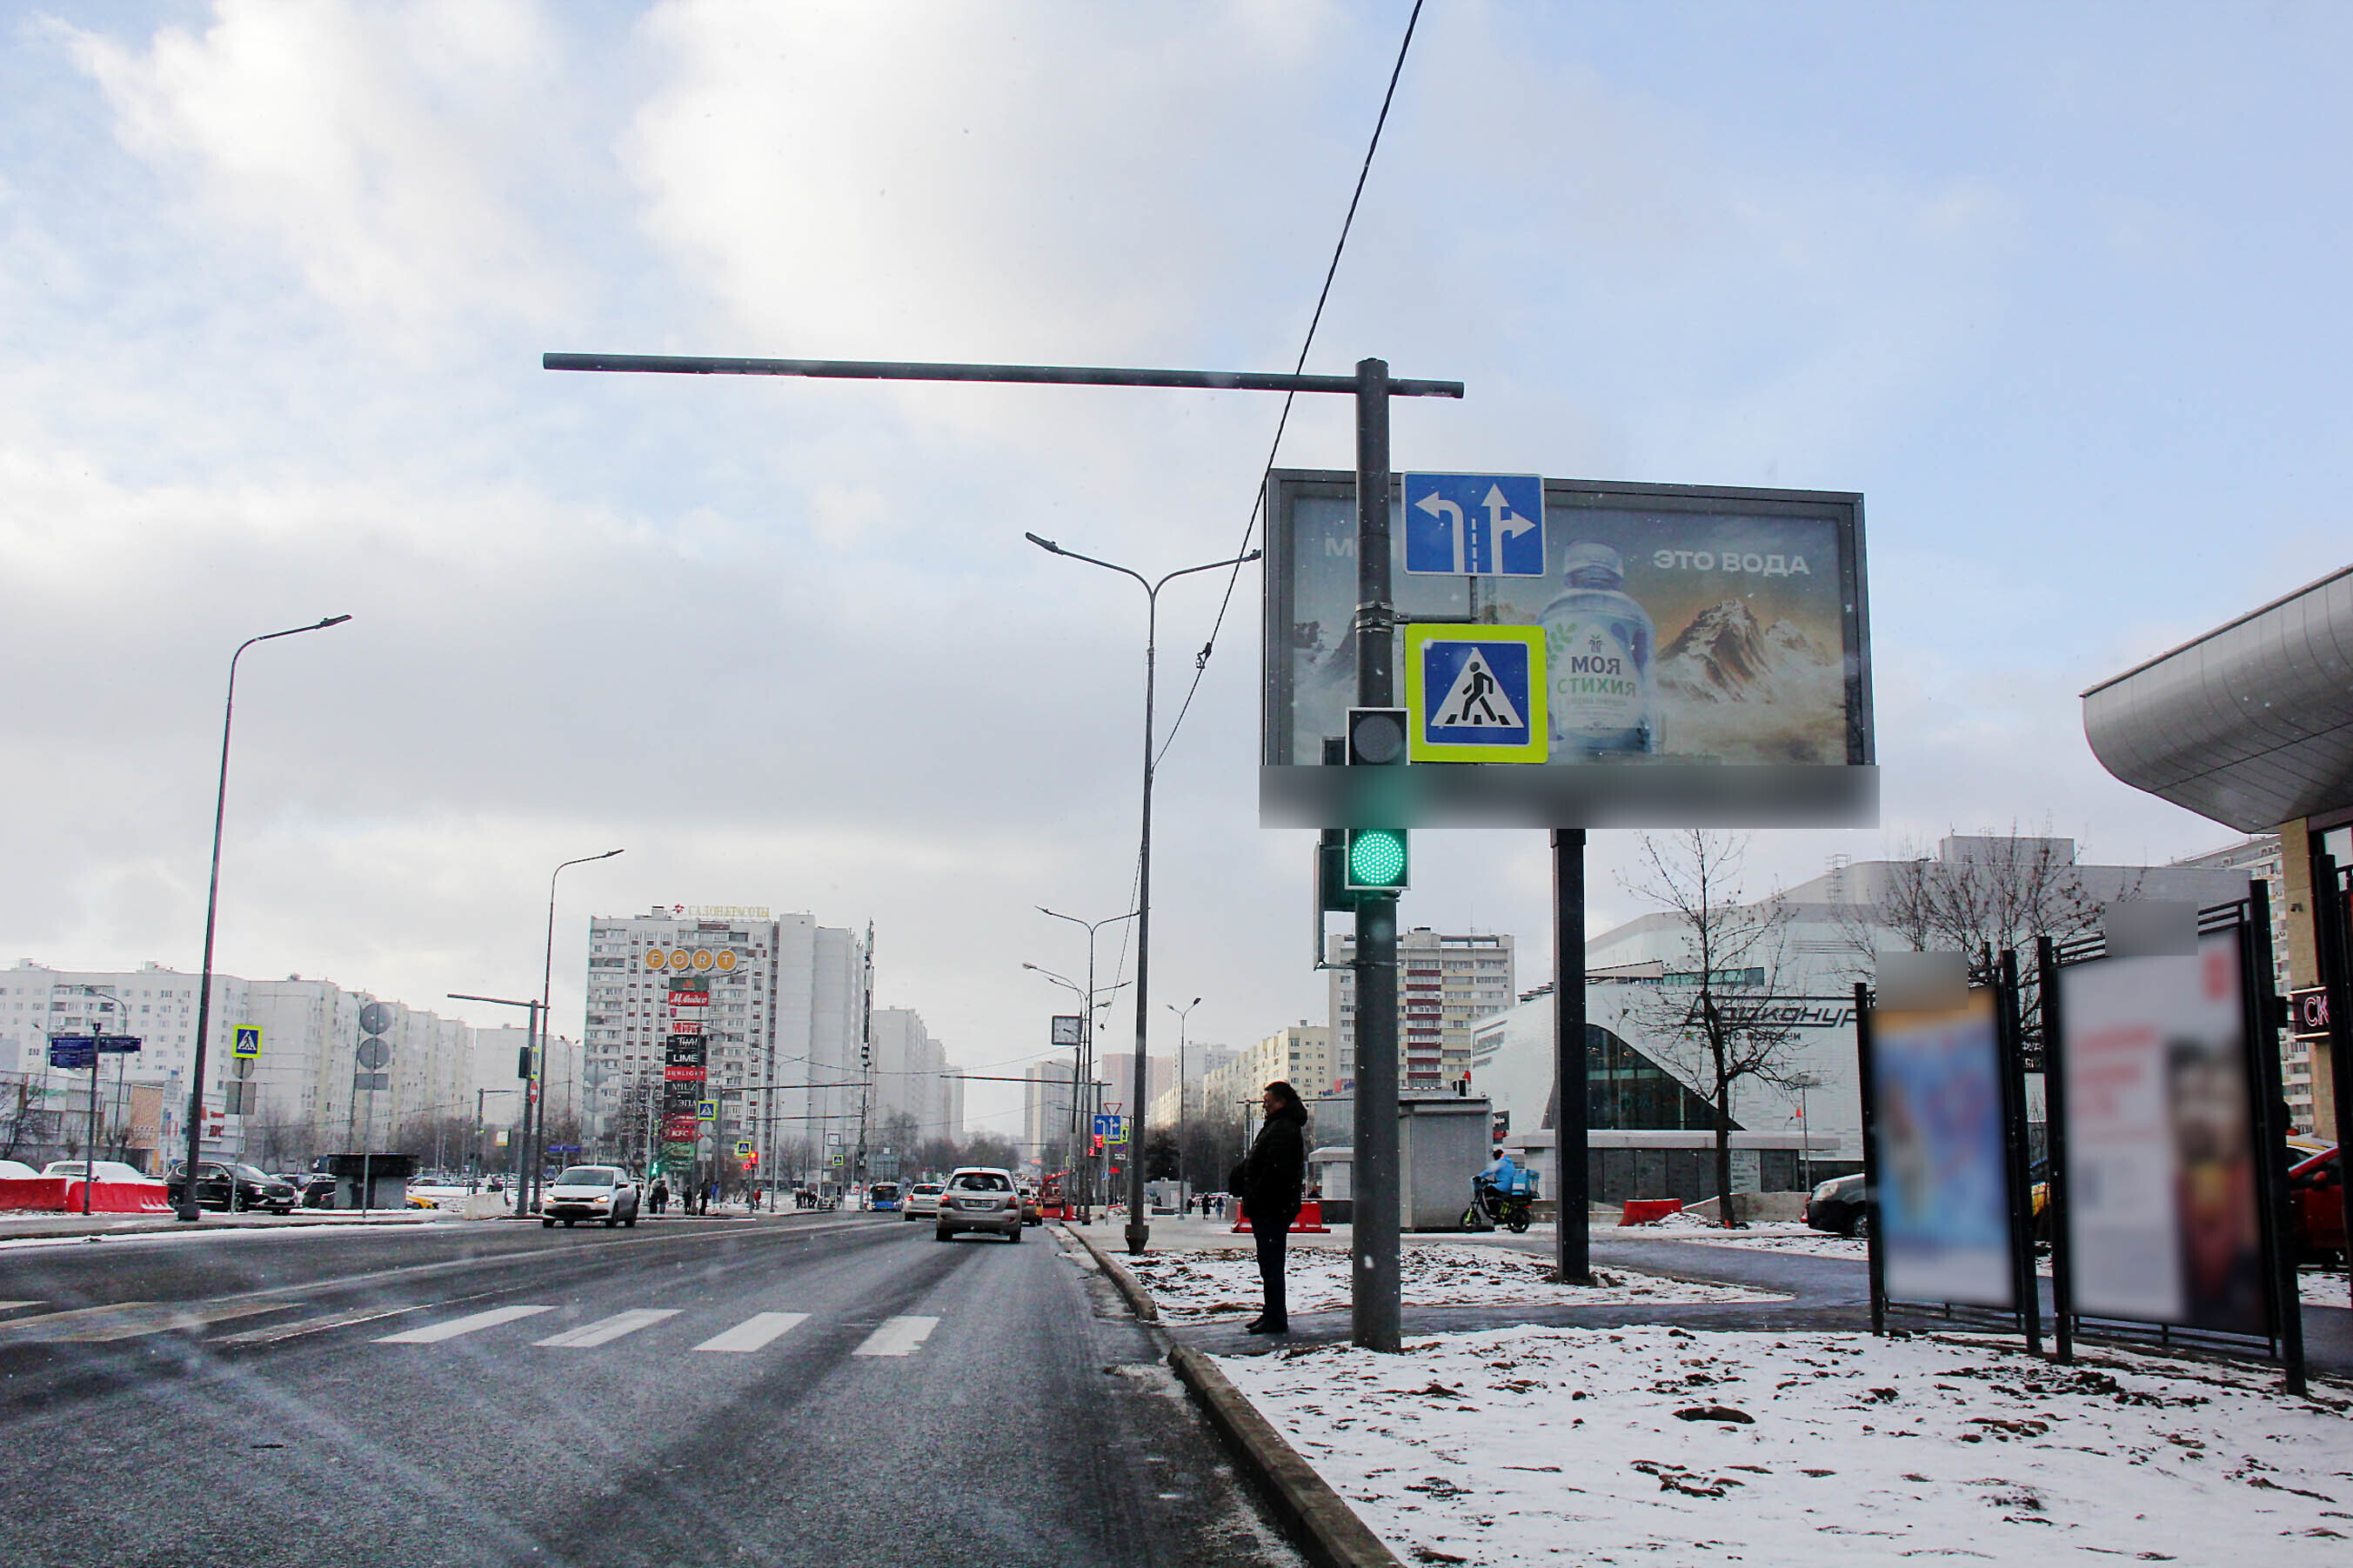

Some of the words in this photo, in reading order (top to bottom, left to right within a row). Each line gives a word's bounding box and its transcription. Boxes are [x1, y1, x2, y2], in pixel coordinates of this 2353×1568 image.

[1654, 549, 1715, 570] ЭТО
[1722, 552, 1810, 577] ВОДА
[1571, 655, 1621, 675] МОЯ
[1557, 677, 1636, 697] СТИХИЯ
